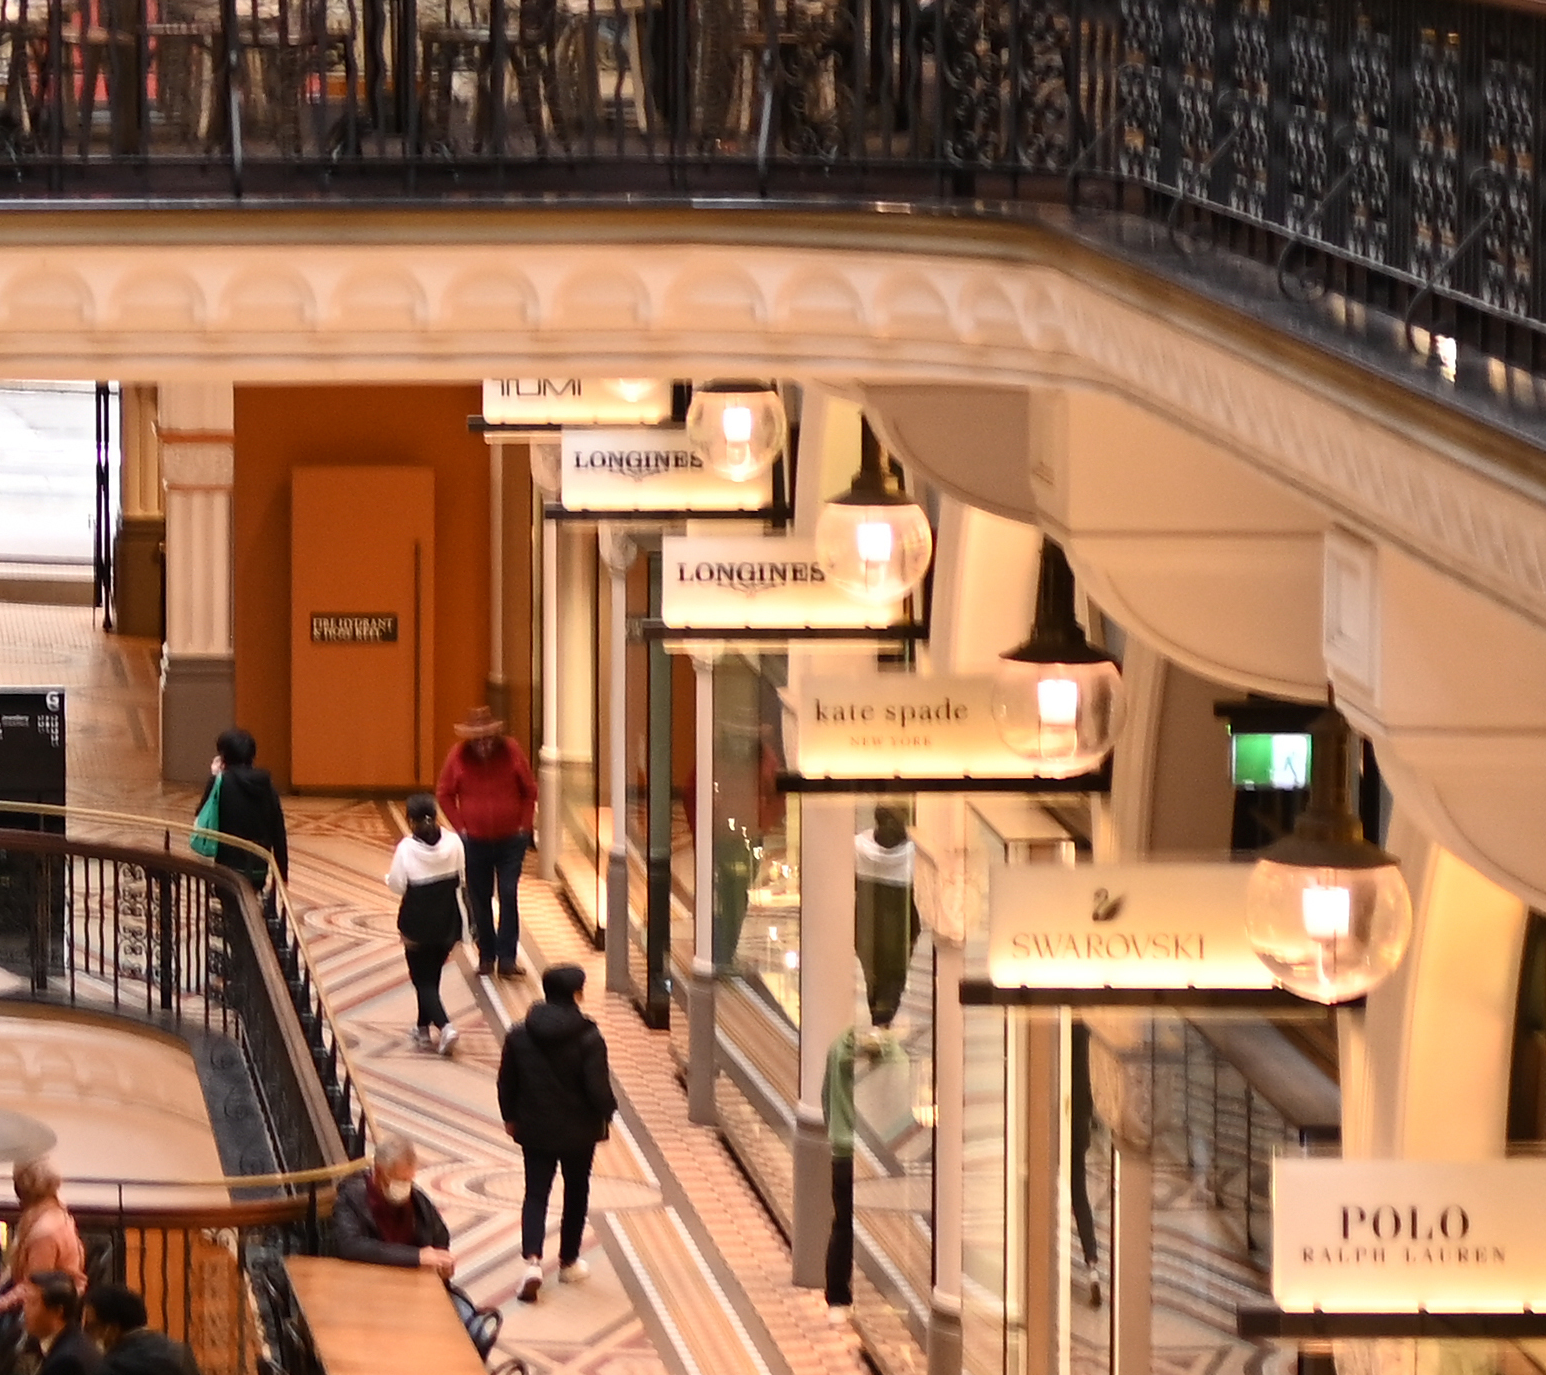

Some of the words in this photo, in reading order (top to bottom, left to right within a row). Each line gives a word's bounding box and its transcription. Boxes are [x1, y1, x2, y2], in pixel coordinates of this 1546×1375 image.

[490, 378, 582, 398] TUMI
[574, 449, 704, 469] LONGINES
[676, 561, 827, 582] LONGINES
[312, 617, 337, 628] FIRE
[338, 617, 394, 631] HYDRANT
[46, 691, 60, 708] G
[815, 698, 876, 722] kate
[885, 697, 969, 728] spade
[851, 735, 884, 746] NEW
[890, 735, 933, 747] YORK
[1012, 933, 1205, 959] SWAROVSKI
[1340, 1204, 1470, 1241] POLO
[1302, 1247, 1386, 1263] RALPH
[1405, 1246, 1506, 1263] LAUREN
